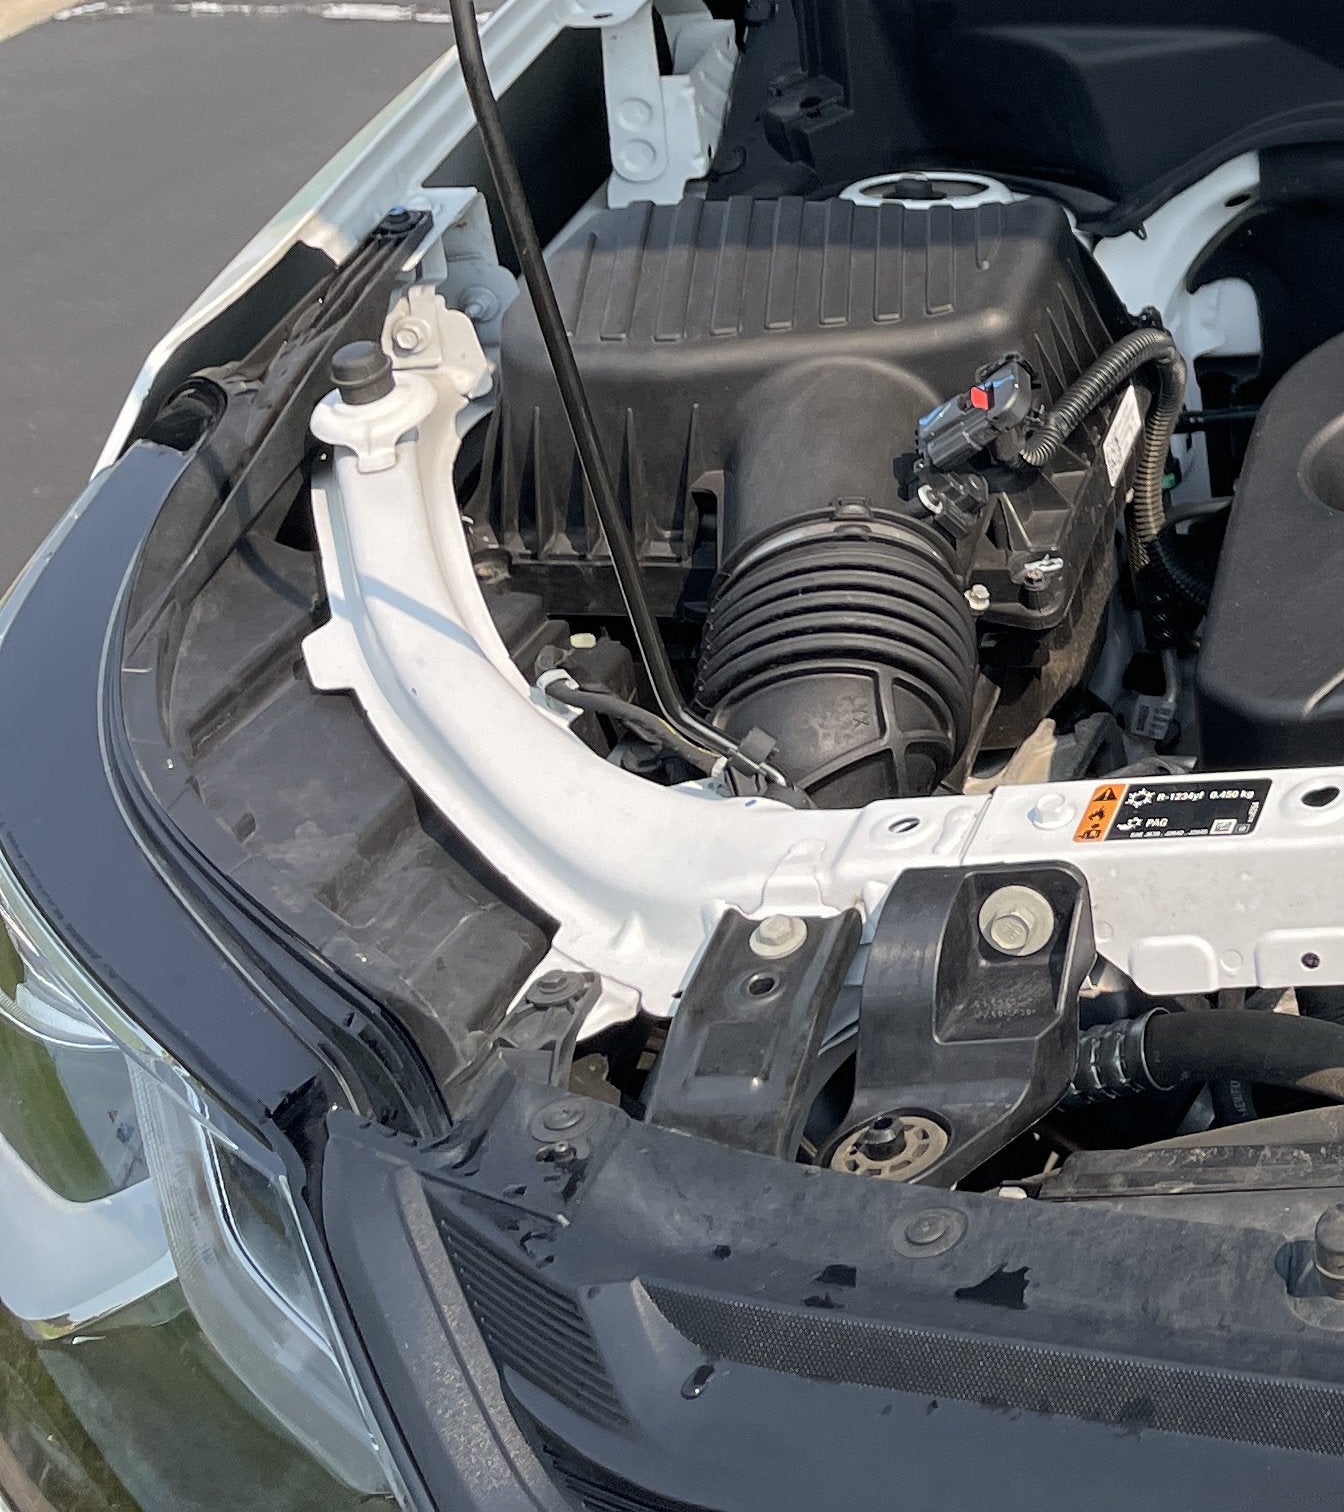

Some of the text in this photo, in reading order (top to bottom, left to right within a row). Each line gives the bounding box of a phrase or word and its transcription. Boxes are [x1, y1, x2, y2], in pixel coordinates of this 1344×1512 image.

[1156, 789, 1254, 801] R-1234yf 0.450 kg
[1145, 818, 1168, 827] PAG
